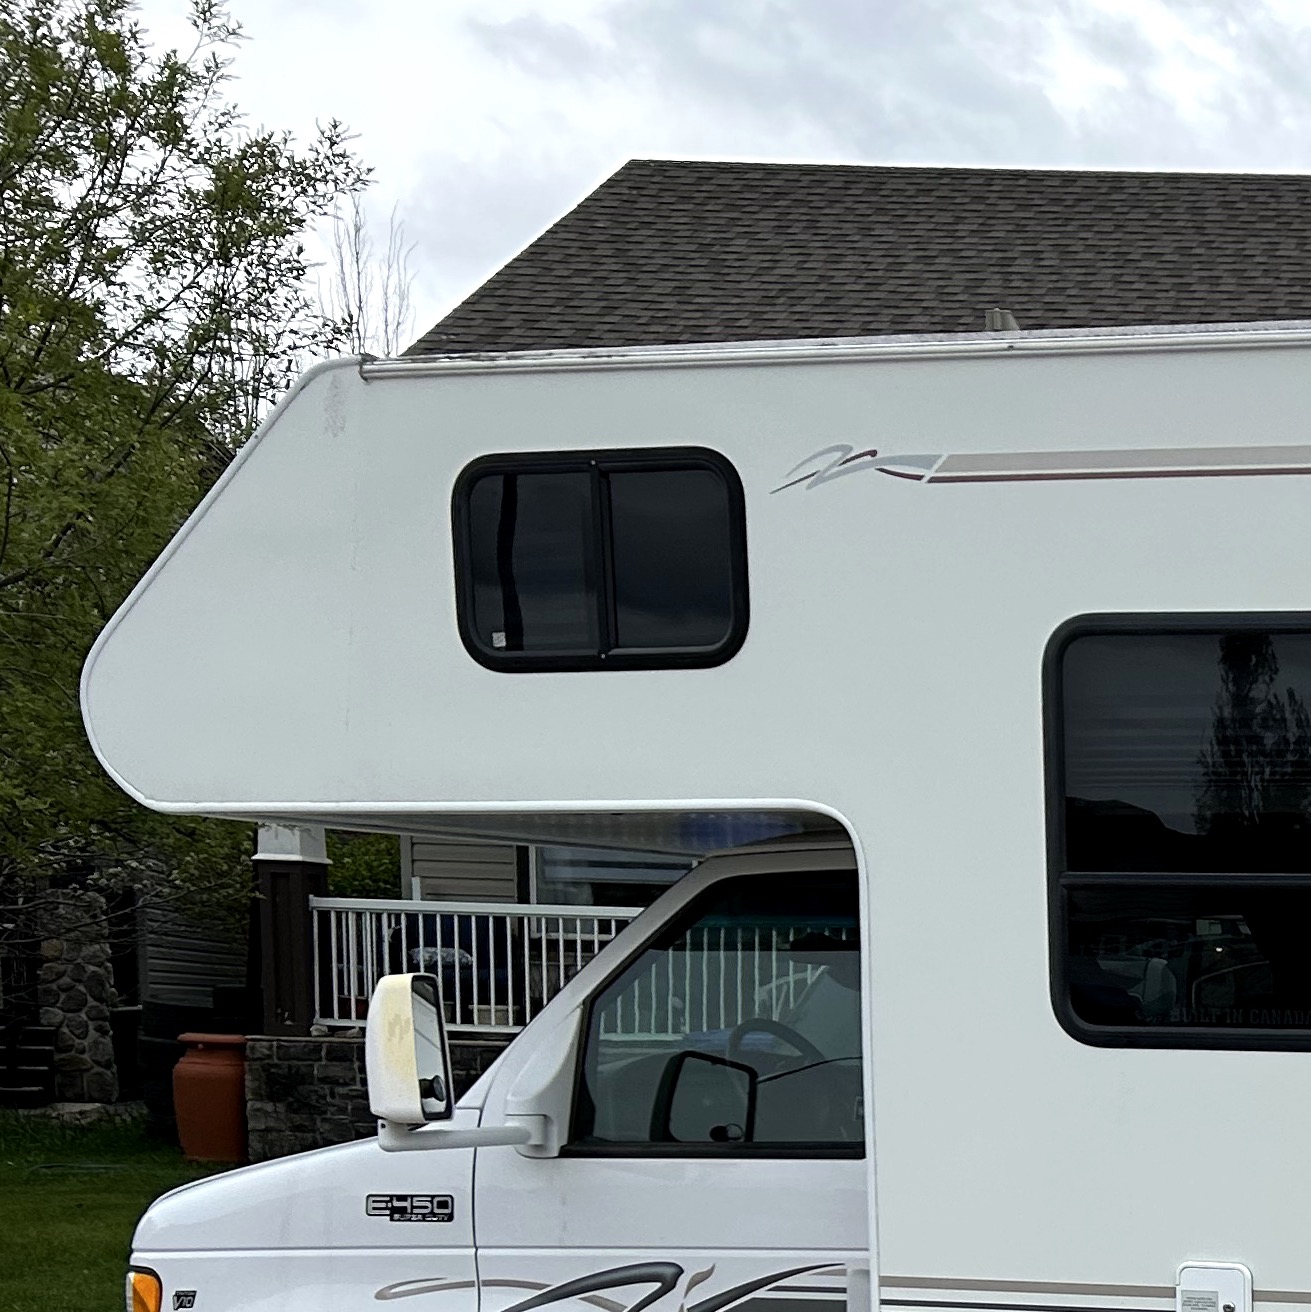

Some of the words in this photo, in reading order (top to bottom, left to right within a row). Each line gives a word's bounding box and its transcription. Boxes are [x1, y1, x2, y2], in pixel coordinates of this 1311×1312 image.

[1169, 1007, 1221, 1024] BUILT
[1225, 1008, 1244, 1024] IN
[173, 1295, 194, 1309] V10
